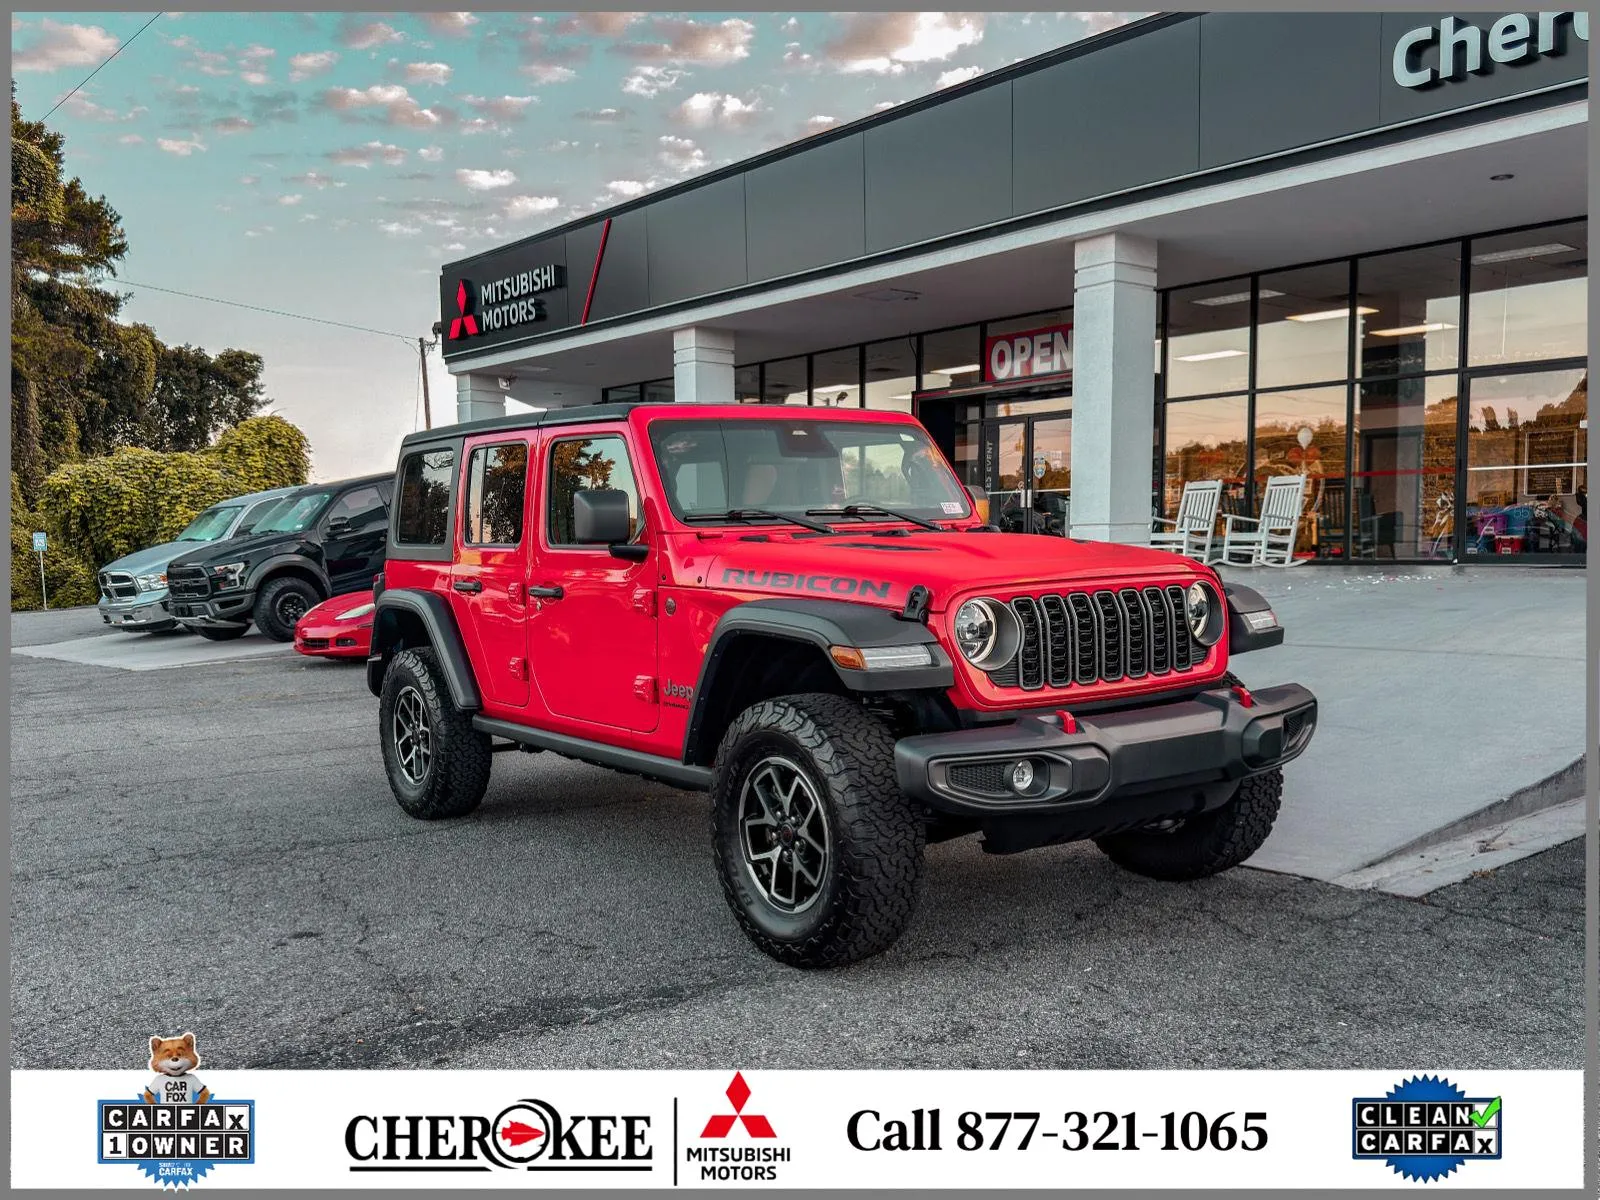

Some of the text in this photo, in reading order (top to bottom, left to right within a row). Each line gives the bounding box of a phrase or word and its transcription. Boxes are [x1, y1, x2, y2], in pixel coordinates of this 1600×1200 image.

[481, 264, 555, 305] MITSUBISHI
[482, 298, 536, 332] MOTORS
[991, 331, 1074, 379] OPEN
[722, 568, 891, 598] RUBICON
[663, 678, 694, 701] Jeep
